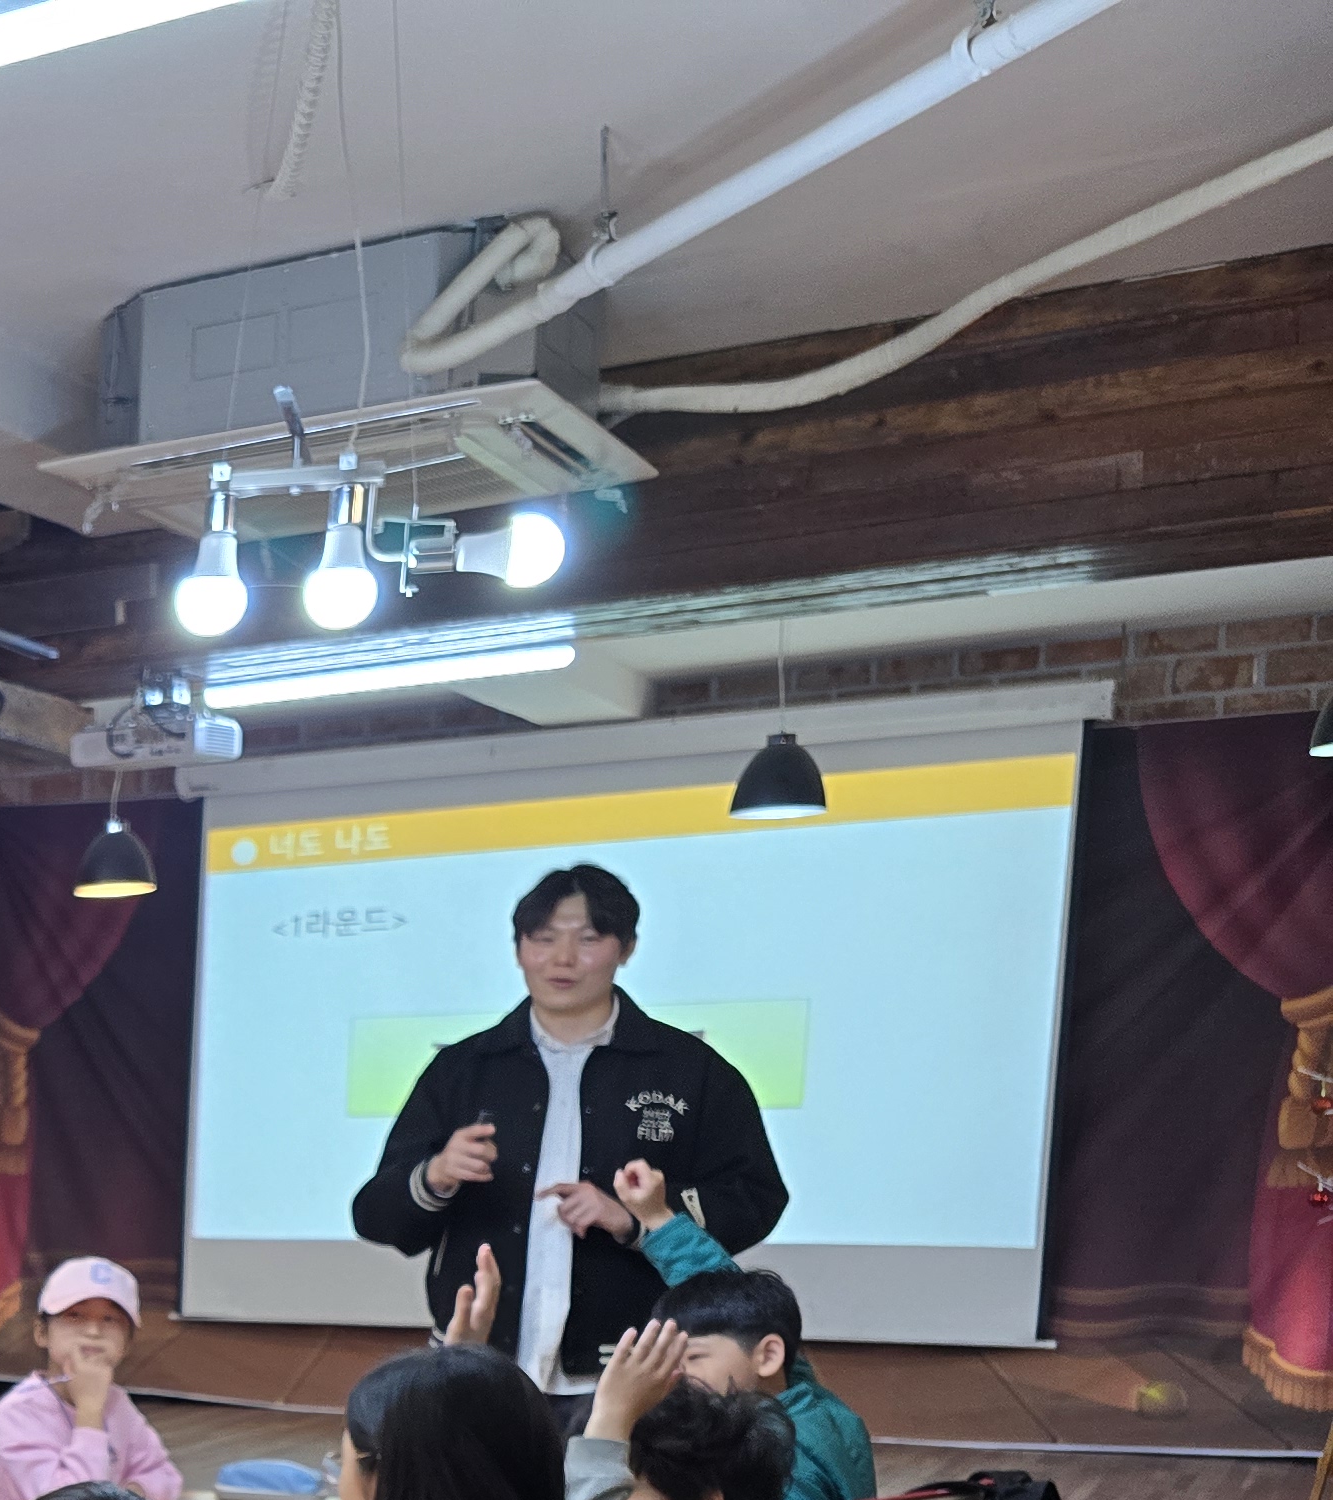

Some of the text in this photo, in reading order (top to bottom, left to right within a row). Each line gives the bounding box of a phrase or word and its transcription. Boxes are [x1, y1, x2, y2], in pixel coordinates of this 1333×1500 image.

[268, 822, 393, 861] 너도 나도
[271, 906, 409, 939] <1라운드>
[624, 1089, 691, 1117] KODAK
